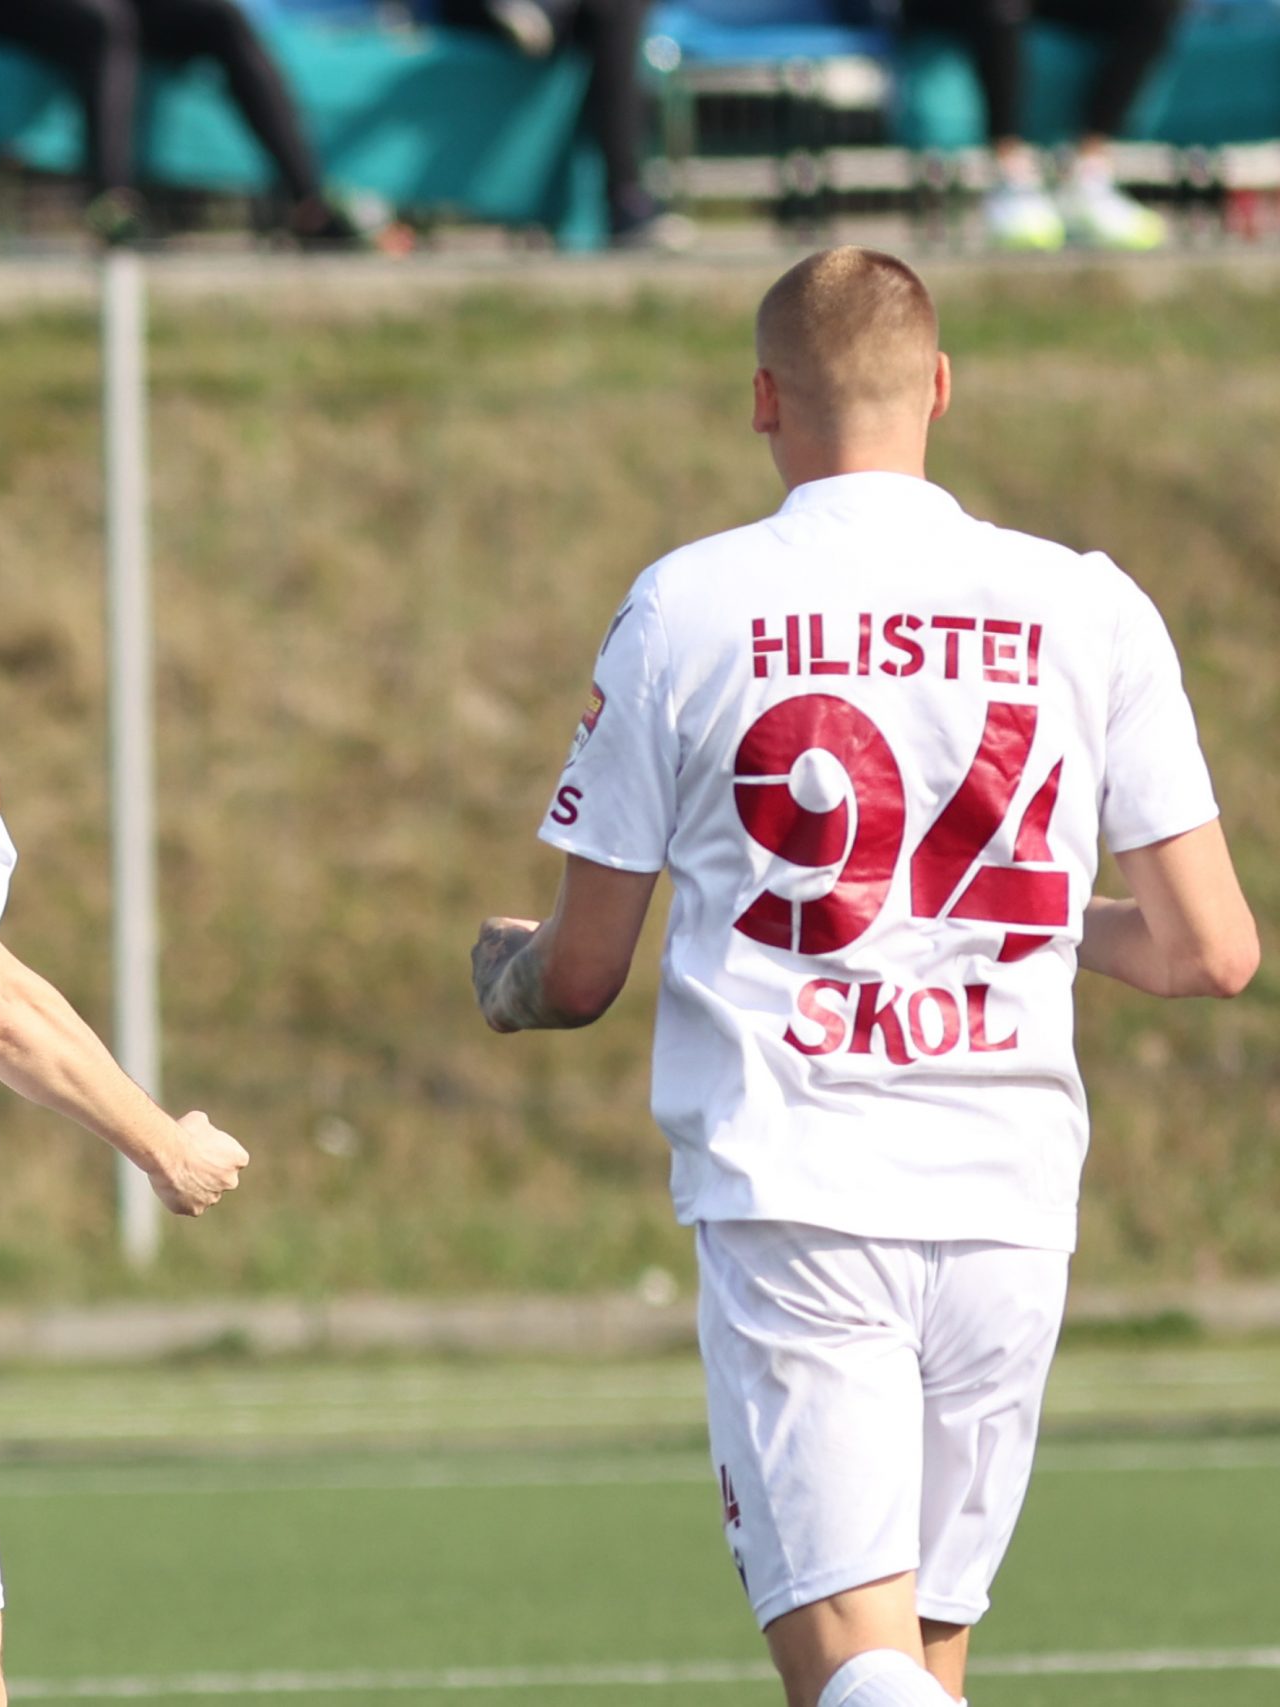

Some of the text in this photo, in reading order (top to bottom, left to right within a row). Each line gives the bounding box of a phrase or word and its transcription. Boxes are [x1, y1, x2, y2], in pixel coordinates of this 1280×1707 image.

[751, 612, 1043, 687] HLISTEI
[732, 692, 1070, 964] 94
[782, 977, 1019, 1066] SKOL
